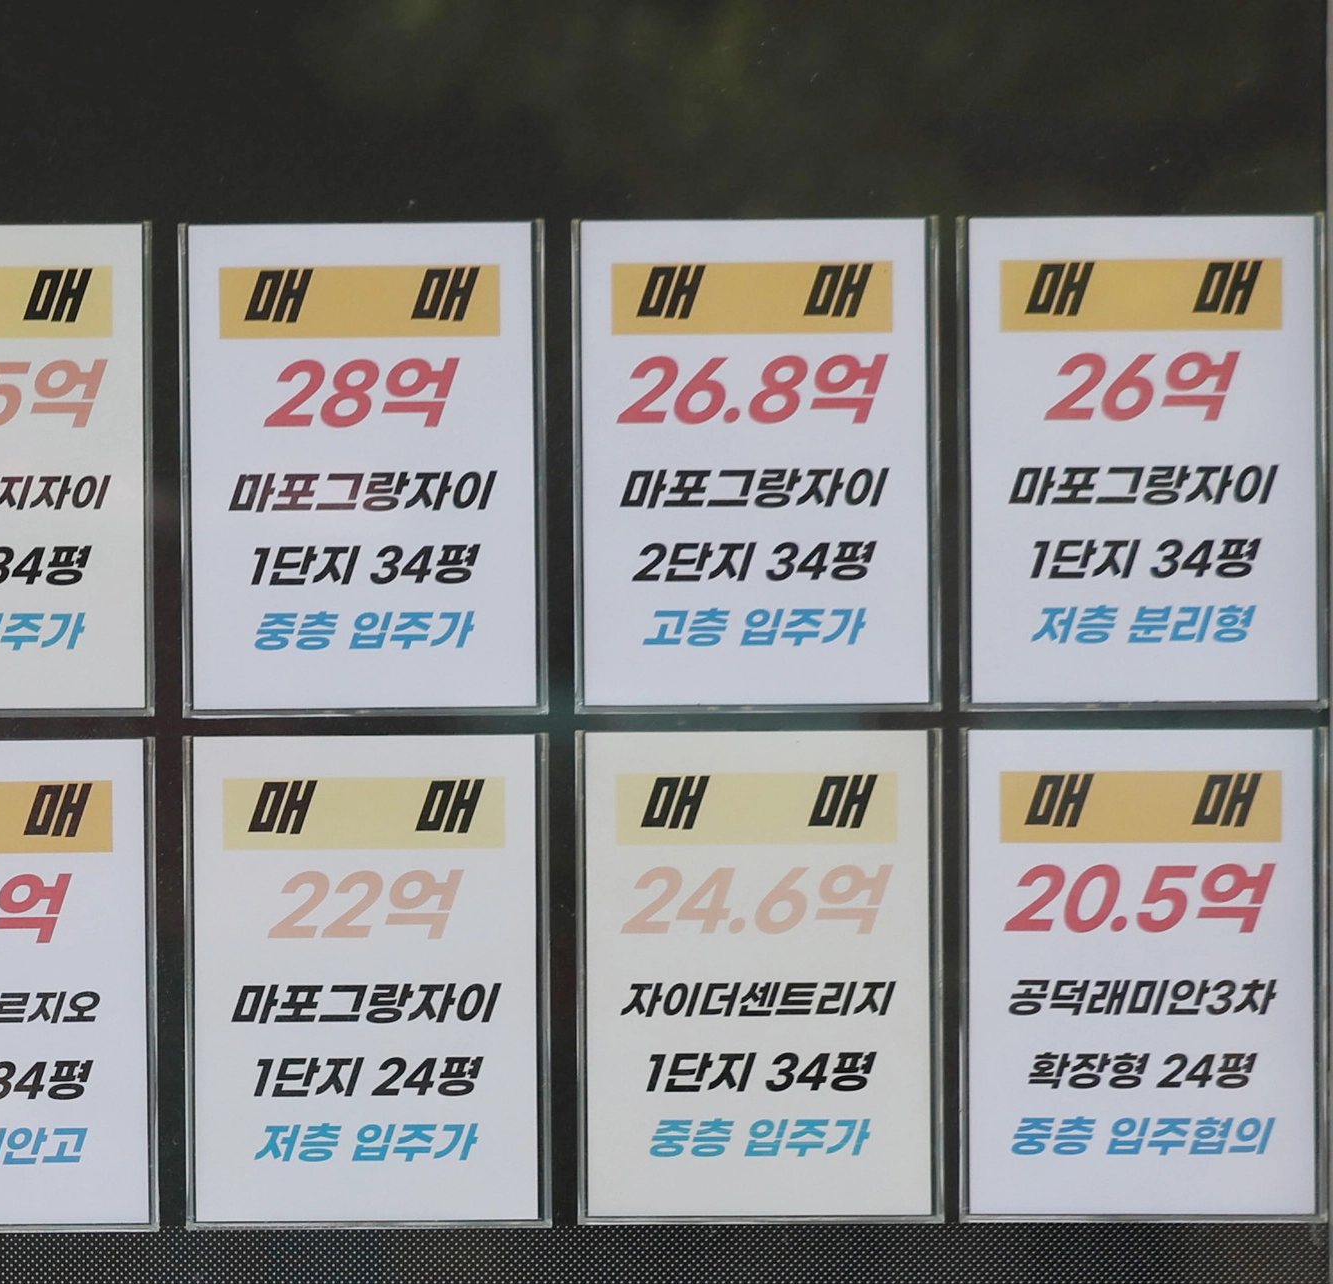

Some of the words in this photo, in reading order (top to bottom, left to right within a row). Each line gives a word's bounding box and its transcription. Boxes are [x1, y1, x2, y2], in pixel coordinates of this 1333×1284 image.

[24, 269, 92, 322] 매
[245, 269, 313, 322] 매
[412, 268, 479, 320] 매
[638, 266, 705, 318] 매
[805, 264, 872, 317] 매
[1026, 263, 1094, 315] 매
[1194, 261, 1262, 314] 매
[264, 358, 460, 428] 28억
[617, 354, 888, 424] 26.8억
[1044, 351, 1240, 421] 26억
[229, 471, 497, 512] 마포그랑자이
[620, 468, 889, 509] 마포그랑자이
[1009, 465, 1278, 505] 마포그랑자이
[251, 546, 361, 585] 1단지
[370, 544, 480, 584] 34평
[632, 542, 757, 582] 2단지
[766, 541, 877, 581] 34평
[1031, 539, 1141, 579] 1단지
[1151, 538, 1261, 578] 34평
[255, 611, 338, 650] 중층
[349, 611, 474, 649] 입주가
[643, 608, 730, 646] 고층
[741, 608, 866, 646] 입주가
[1032, 605, 1118, 643] 저층
[1128, 605, 1256, 643] 분리형
[24, 784, 92, 837] 매
[248, 781, 317, 834] 매
[416, 780, 484, 833] 매
[641, 776, 709, 829] 매
[809, 775, 877, 828] 매
[1026, 774, 1093, 827] 매
[1193, 774, 1261, 826] 매
[268, 870, 463, 938] 22억
[622, 865, 891, 933] 24.6억
[1004, 863, 1276, 933] 20.5억
[231, 983, 501, 1024] 마포그랑자이
[621, 981, 896, 1017] 자이더센트리지
[1009, 979, 1277, 1015] 공덕래미안3차
[254, 1057, 364, 1097] 1단지
[371, 1057, 484, 1096] 24평
[646, 1053, 757, 1092] 1단지
[766, 1052, 877, 1092] 34평
[1029, 1052, 1150, 1089] 확장형
[1156, 1053, 1257, 1088] 24평
[255, 1123, 341, 1162] 저층
[352, 1123, 478, 1162] 입주가
[650, 1118, 734, 1157] 중층
[745, 1119, 870, 1157] 입주가
[1012, 1117, 1096, 1155] 중층
[1107, 1117, 1275, 1155] 입주협의
